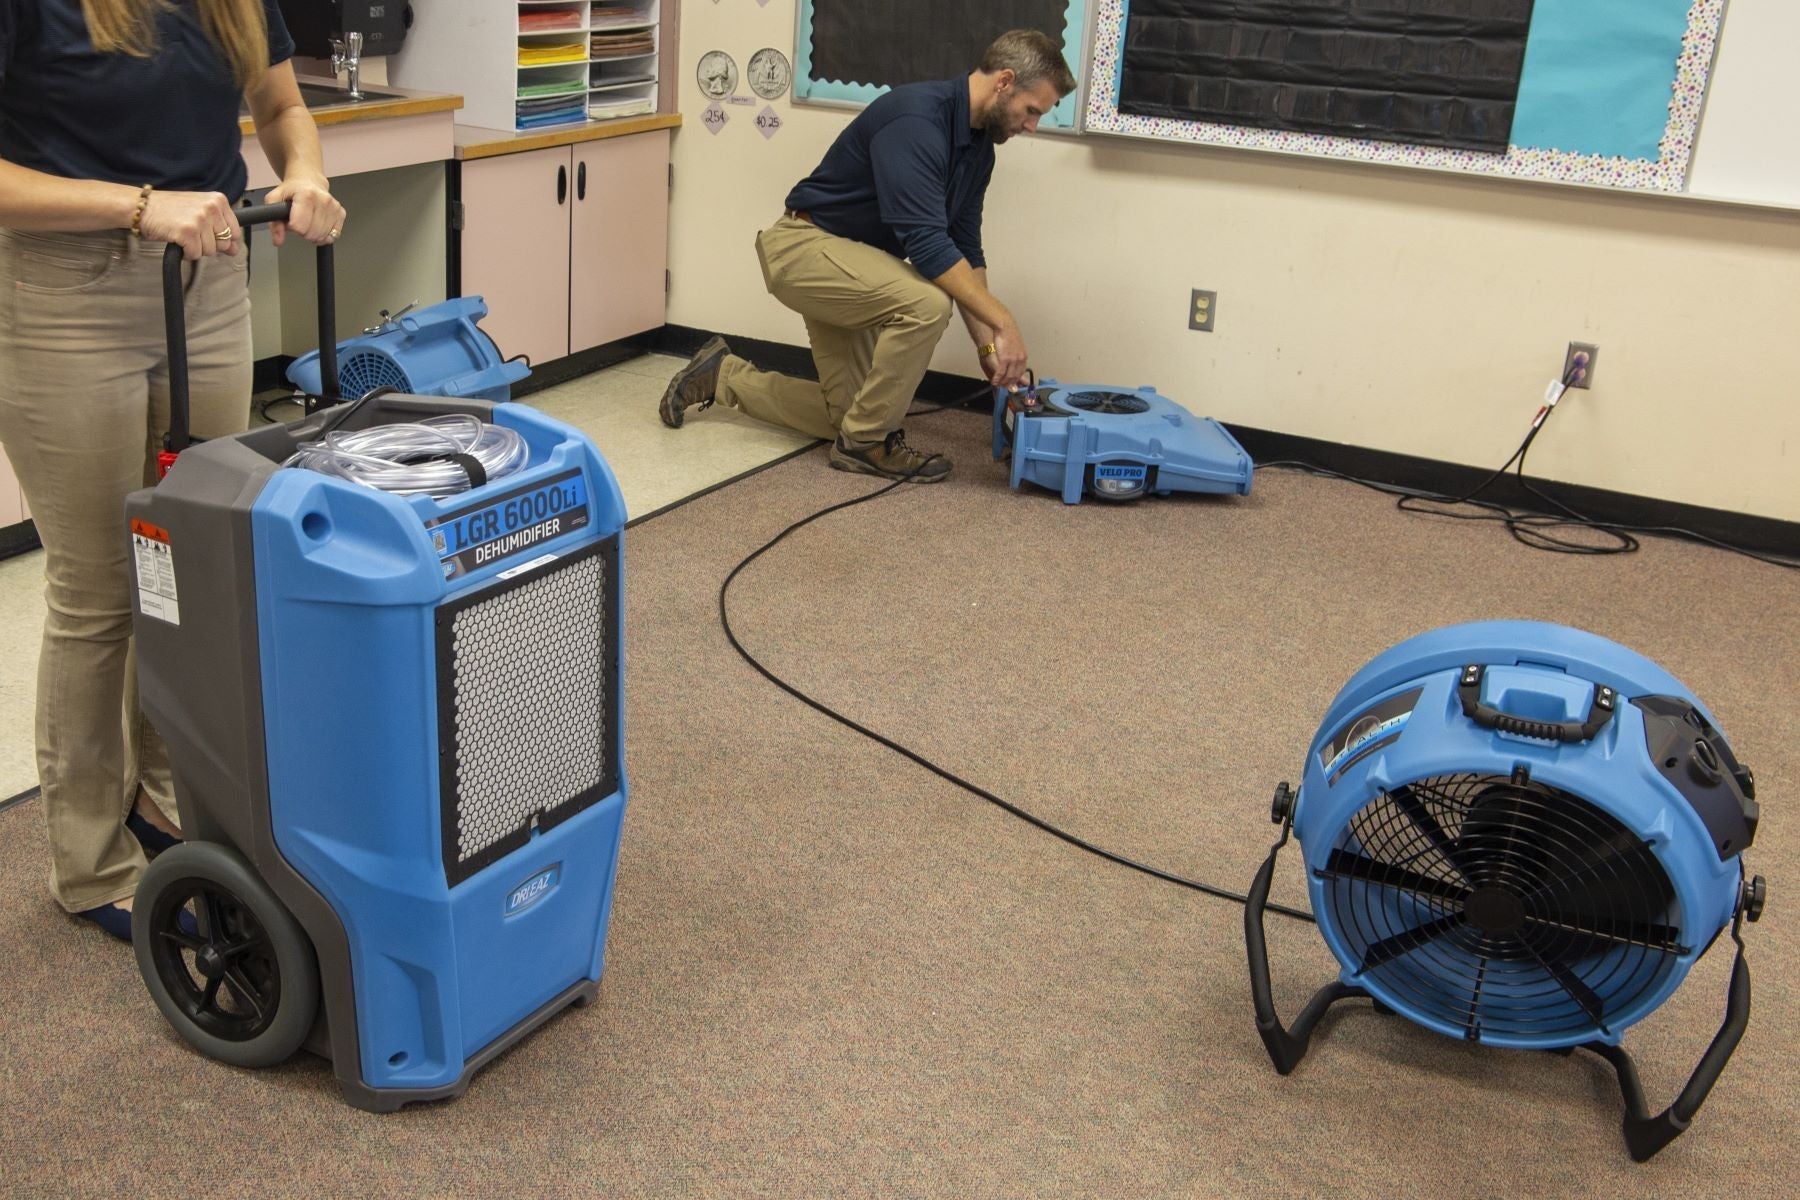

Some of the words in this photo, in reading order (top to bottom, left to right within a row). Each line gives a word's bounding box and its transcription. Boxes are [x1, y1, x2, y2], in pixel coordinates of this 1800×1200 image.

[756, 115, 780, 128] $0.25
[1100, 468, 1122, 477] VELO
[1124, 468, 1143, 477] PRO
[454, 509, 500, 549] LGR
[475, 518, 561, 565] DEHUMIDIFIER
[1330, 717, 1401, 769] STEALTH
